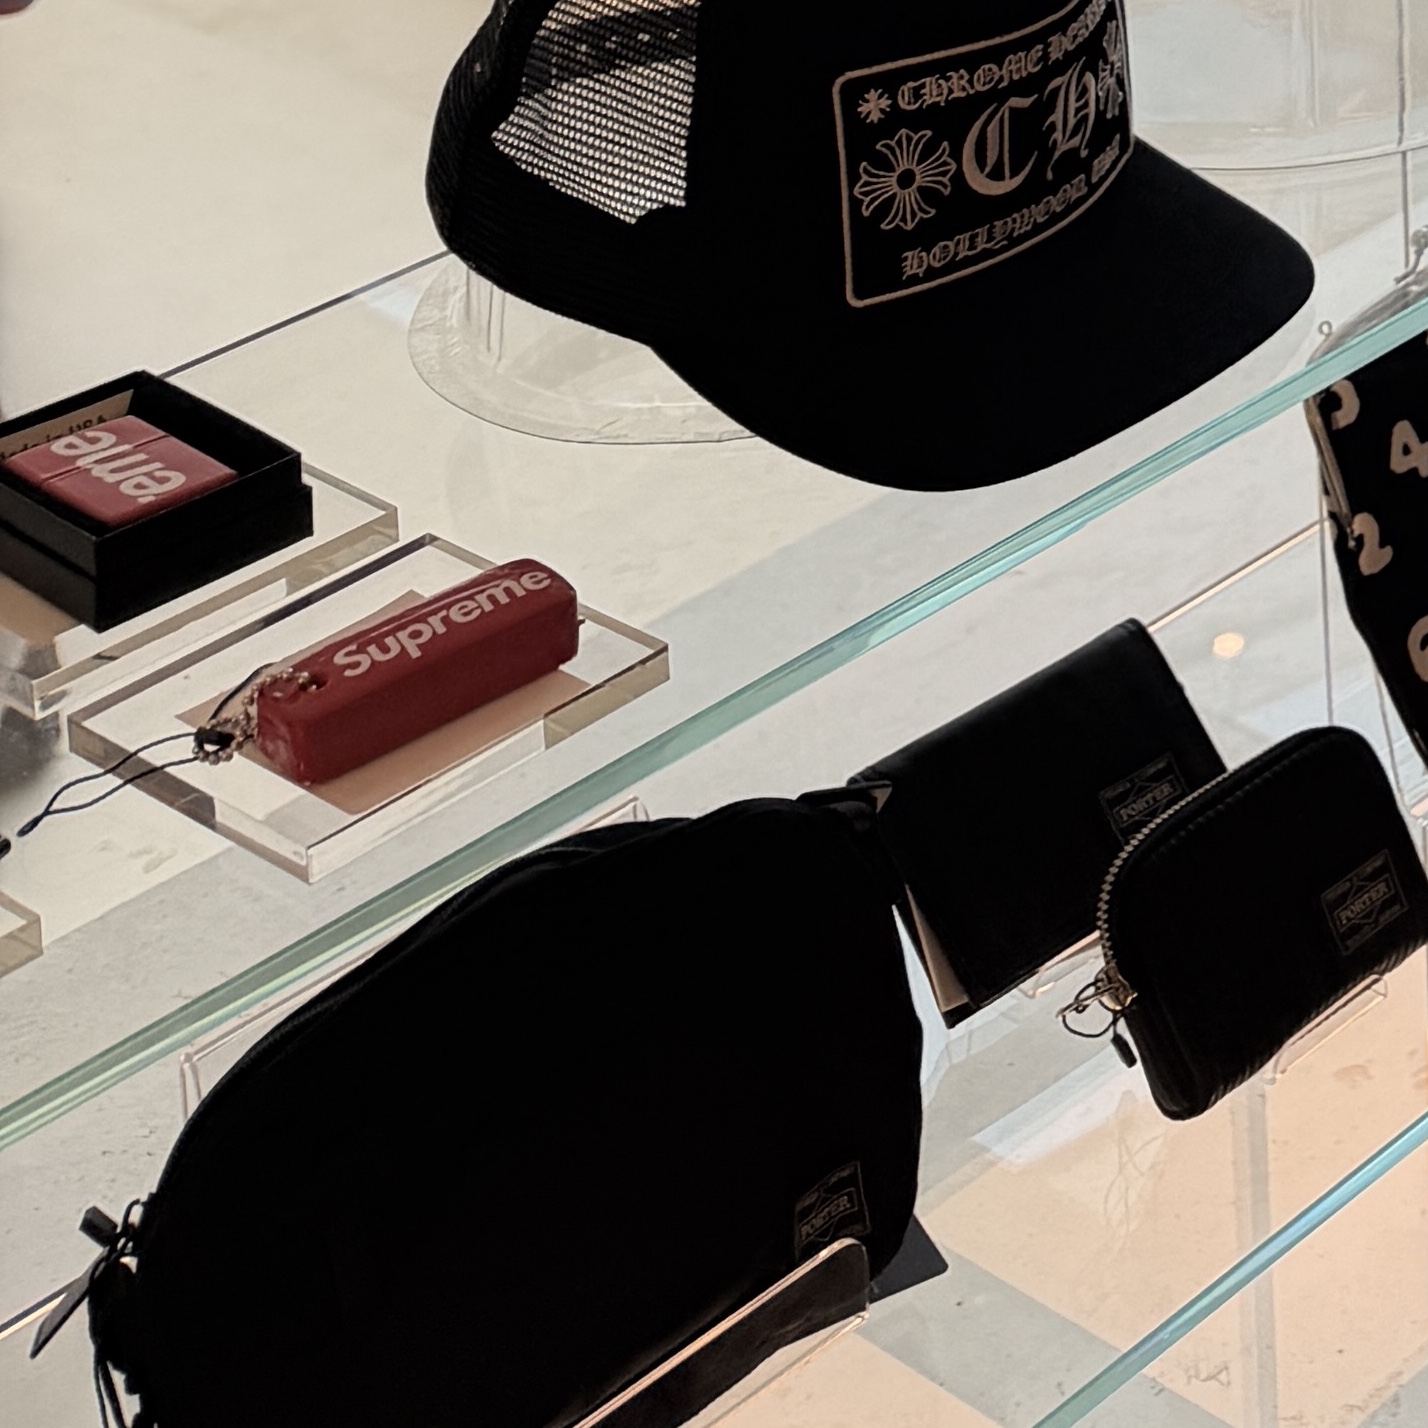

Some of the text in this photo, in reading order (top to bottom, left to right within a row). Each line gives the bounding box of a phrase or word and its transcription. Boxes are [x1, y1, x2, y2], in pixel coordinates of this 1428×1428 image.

[898, 45, 1044, 110] CHROME
[902, 174, 1089, 280] HOLLYWOOD
[50, 431, 187, 504] eme
[1351, 512, 1393, 576] 2
[332, 565, 552, 680] Supreme
[1119, 777, 1175, 823] PORTER
[1338, 880, 1390, 925] PORTER
